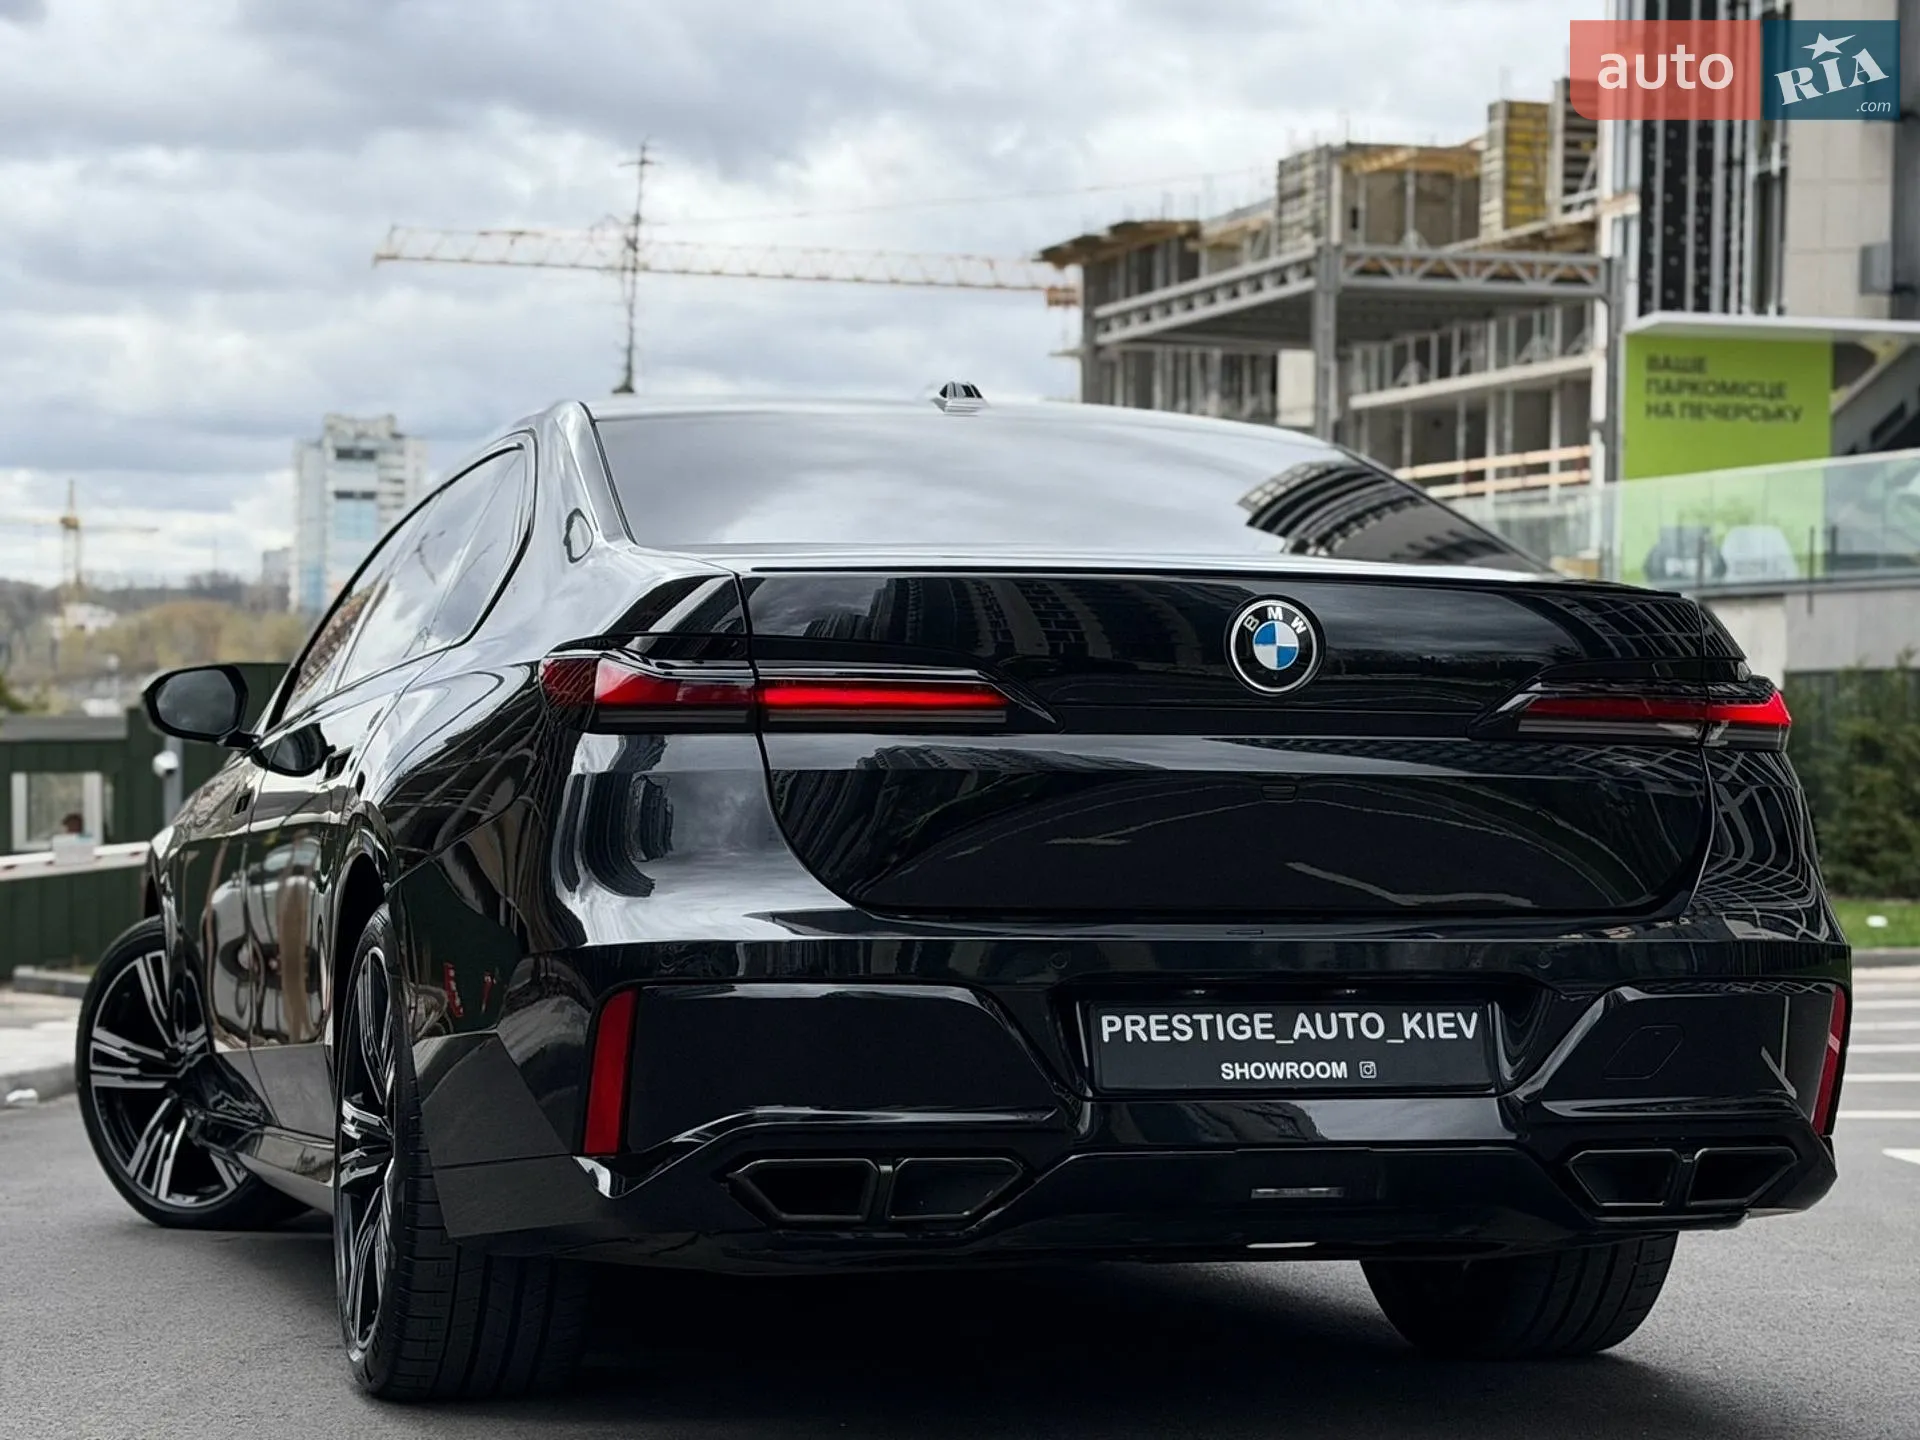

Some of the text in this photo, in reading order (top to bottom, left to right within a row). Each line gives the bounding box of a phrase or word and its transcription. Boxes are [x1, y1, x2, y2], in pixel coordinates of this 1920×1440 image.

[1243, 606, 1307, 634] BMW
[1101, 1011, 1478, 1044] PRESTIGE_AUTO_KIEV
[1221, 1061, 1348, 1081] SHOWROOM
